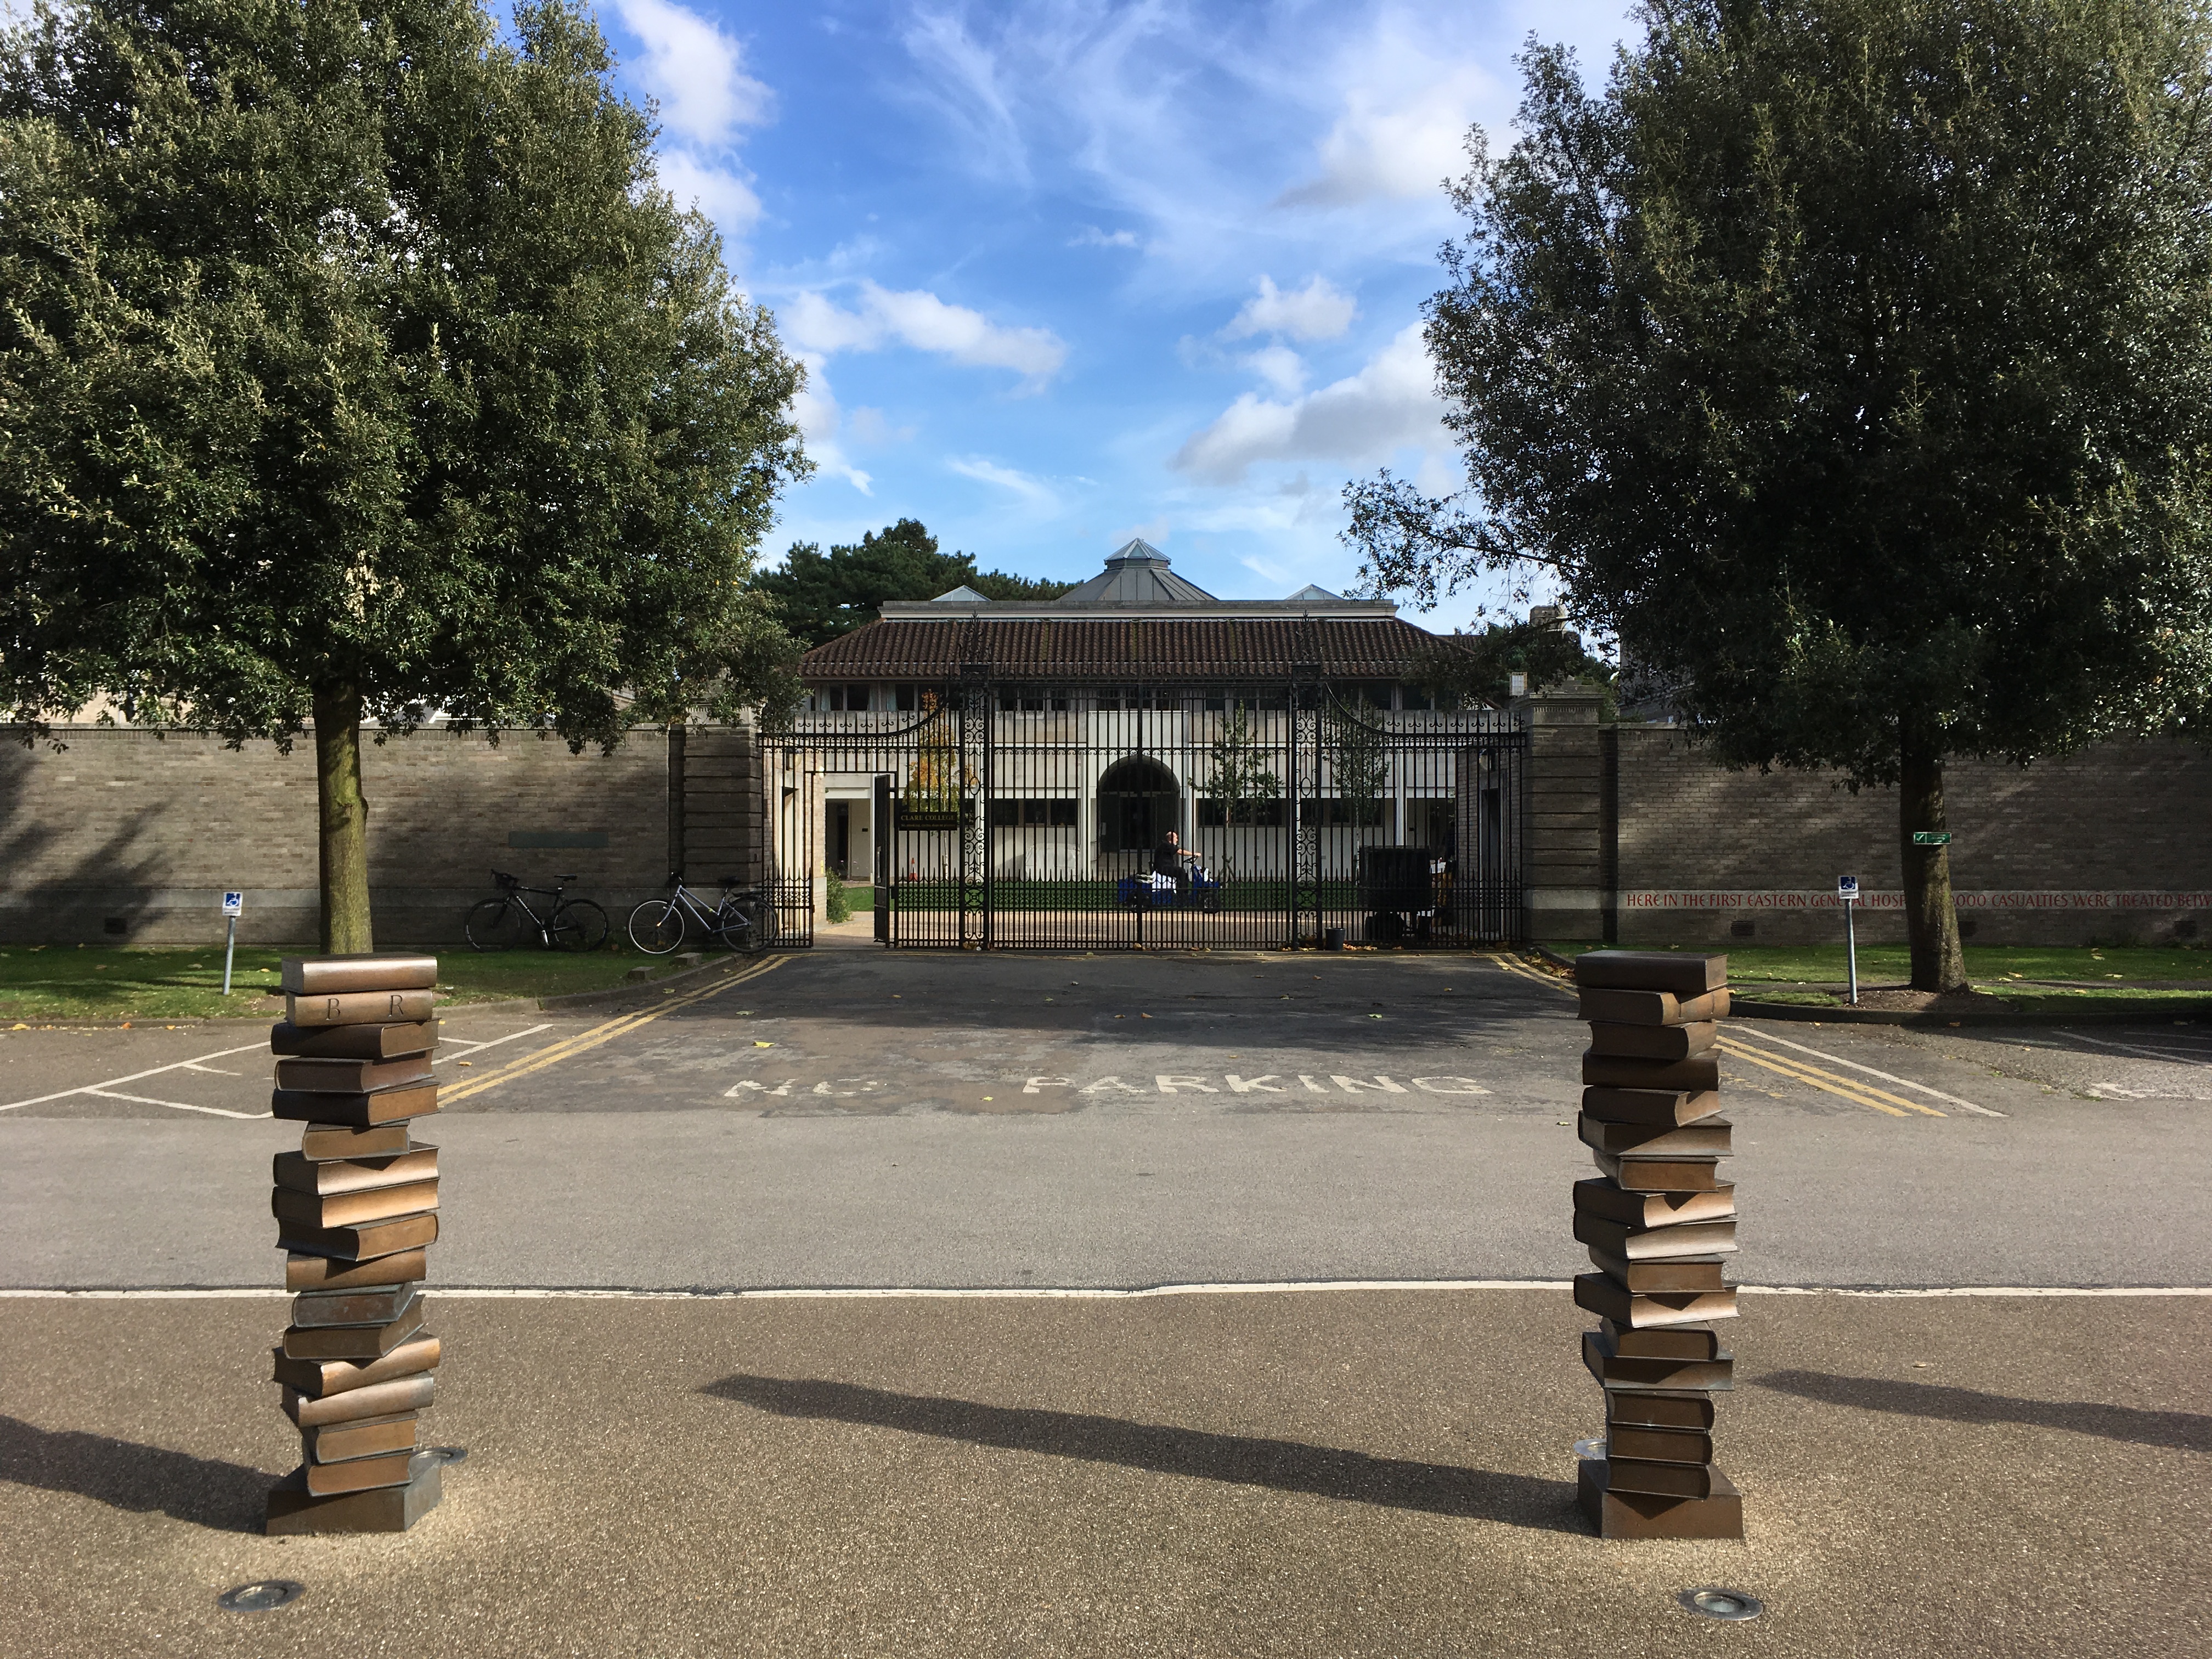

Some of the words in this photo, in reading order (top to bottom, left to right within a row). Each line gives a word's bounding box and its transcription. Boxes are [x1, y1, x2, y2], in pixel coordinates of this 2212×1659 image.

[1627, 894, 1659, 907] HERE
[1664, 894, 1678, 907] IN
[1682, 894, 1705, 907] THE
[1710, 894, 1743, 907] FIRST
[1747, 894, 1805, 907] EASTERN
[1811, 894, 1867, 907] GENEAL
[1872, 894, 1906, 907] HOSP
[1992, 894, 2068, 907] CASUALTIES
[2072, 894, 2111, 907] WERE
[2114, 894, 2174, 907] TREATED
[2177, 894, 2212, 907] BETW
[326, 998, 341, 1020] B
[388, 995, 404, 1017] R
[1022, 1074, 1496, 1096] PARKING
